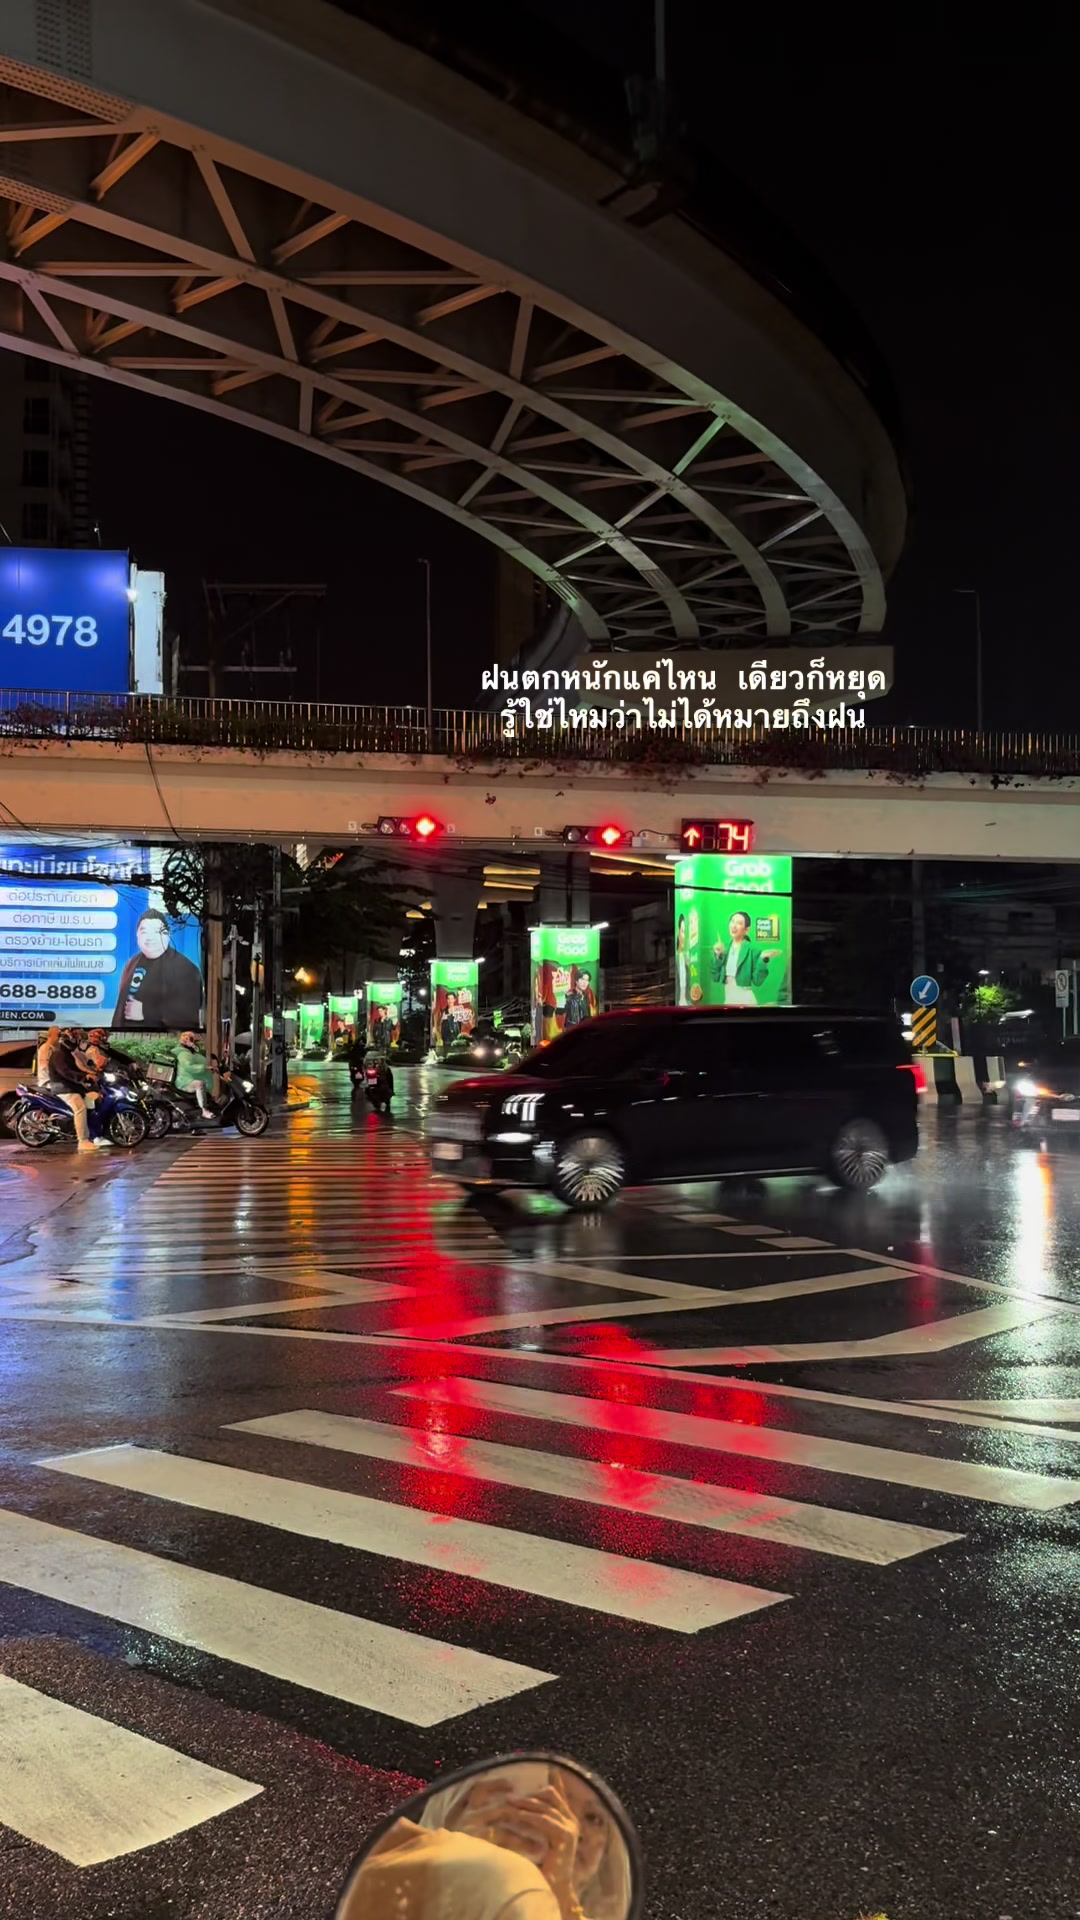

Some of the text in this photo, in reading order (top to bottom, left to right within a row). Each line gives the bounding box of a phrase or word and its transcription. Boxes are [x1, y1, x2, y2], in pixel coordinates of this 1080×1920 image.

[2, 614, 98, 647] 4978
[719, 823, 749, 851] 74
[724, 859, 772, 877] Grab
[0, 984, 97, 999] 688-8888
[0, 1010, 45, 1020] IEN.COM
